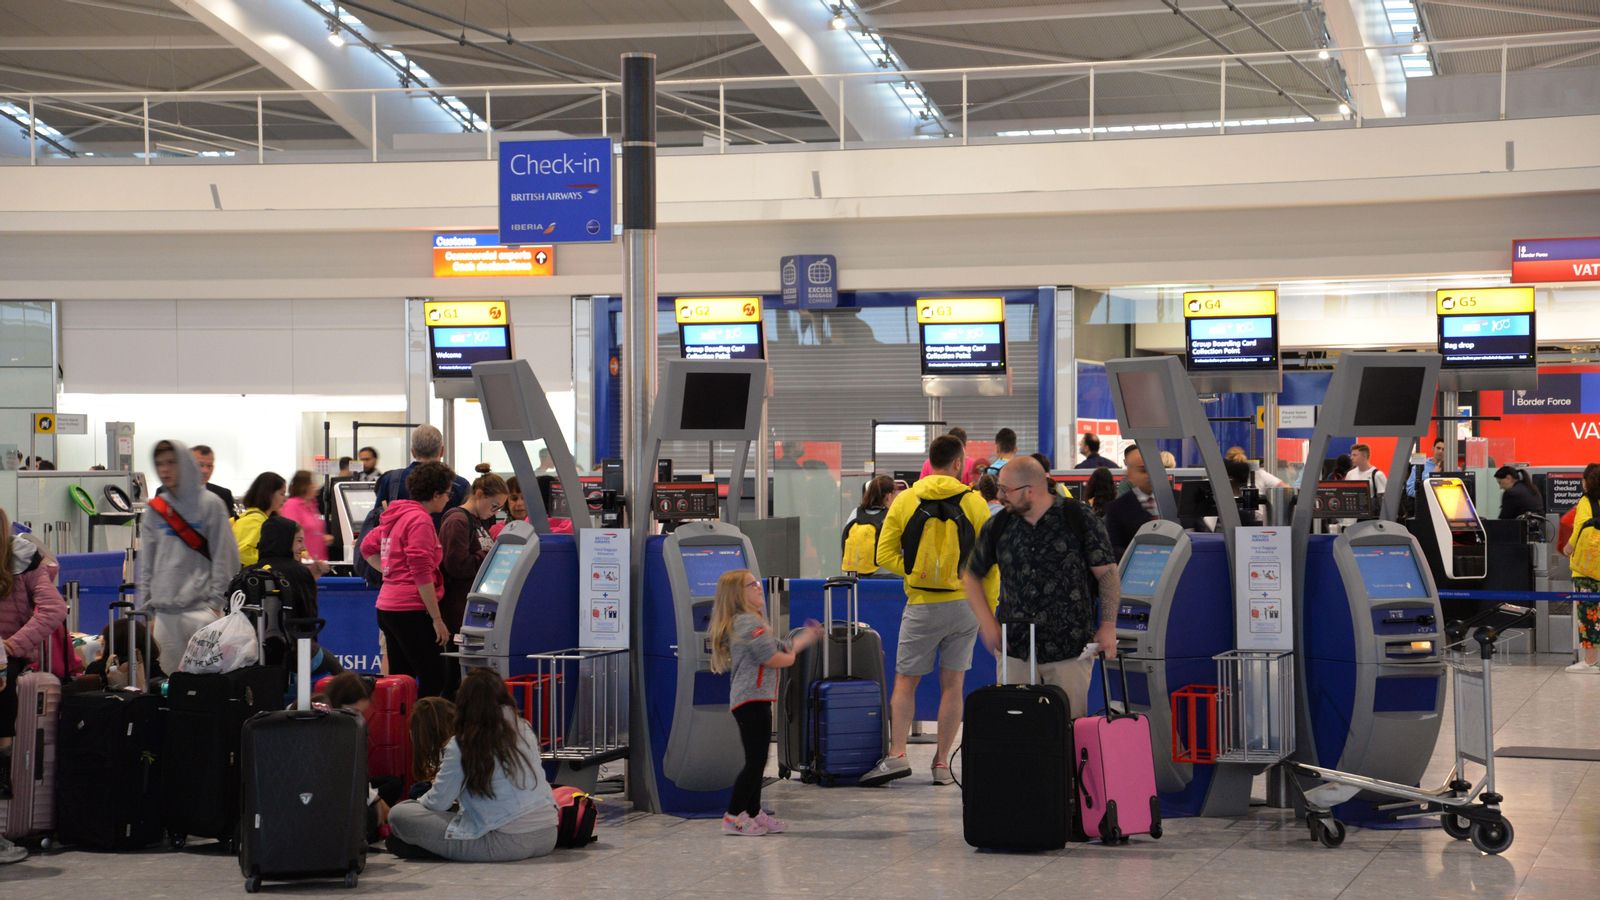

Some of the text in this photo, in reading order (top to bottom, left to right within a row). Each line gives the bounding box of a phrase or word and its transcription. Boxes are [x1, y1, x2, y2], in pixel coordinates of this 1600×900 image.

[510, 152, 600, 175] Check-in
[511, 191, 583, 201] BRITISH AIRWAYS
[511, 223, 544, 231] IBERIA
[436, 236, 477, 246] Customs
[445, 250, 532, 262] Commercial exports
[476, 261, 532, 271] declarations
[1204, 299, 1221, 310] G4
[1459, 297, 1477, 307] G5
[443, 308, 459, 319] G1
[695, 306, 710, 316] G2
[937, 306, 952, 316] G3
[704, 345, 731, 353] Boarding
[925, 345, 944, 353] Group
[944, 345, 971, 353] Boarding
[1444, 342, 1457, 350] Bag
[1517, 397, 1572, 406] Border Force
[1571, 421, 1600, 440] VA
